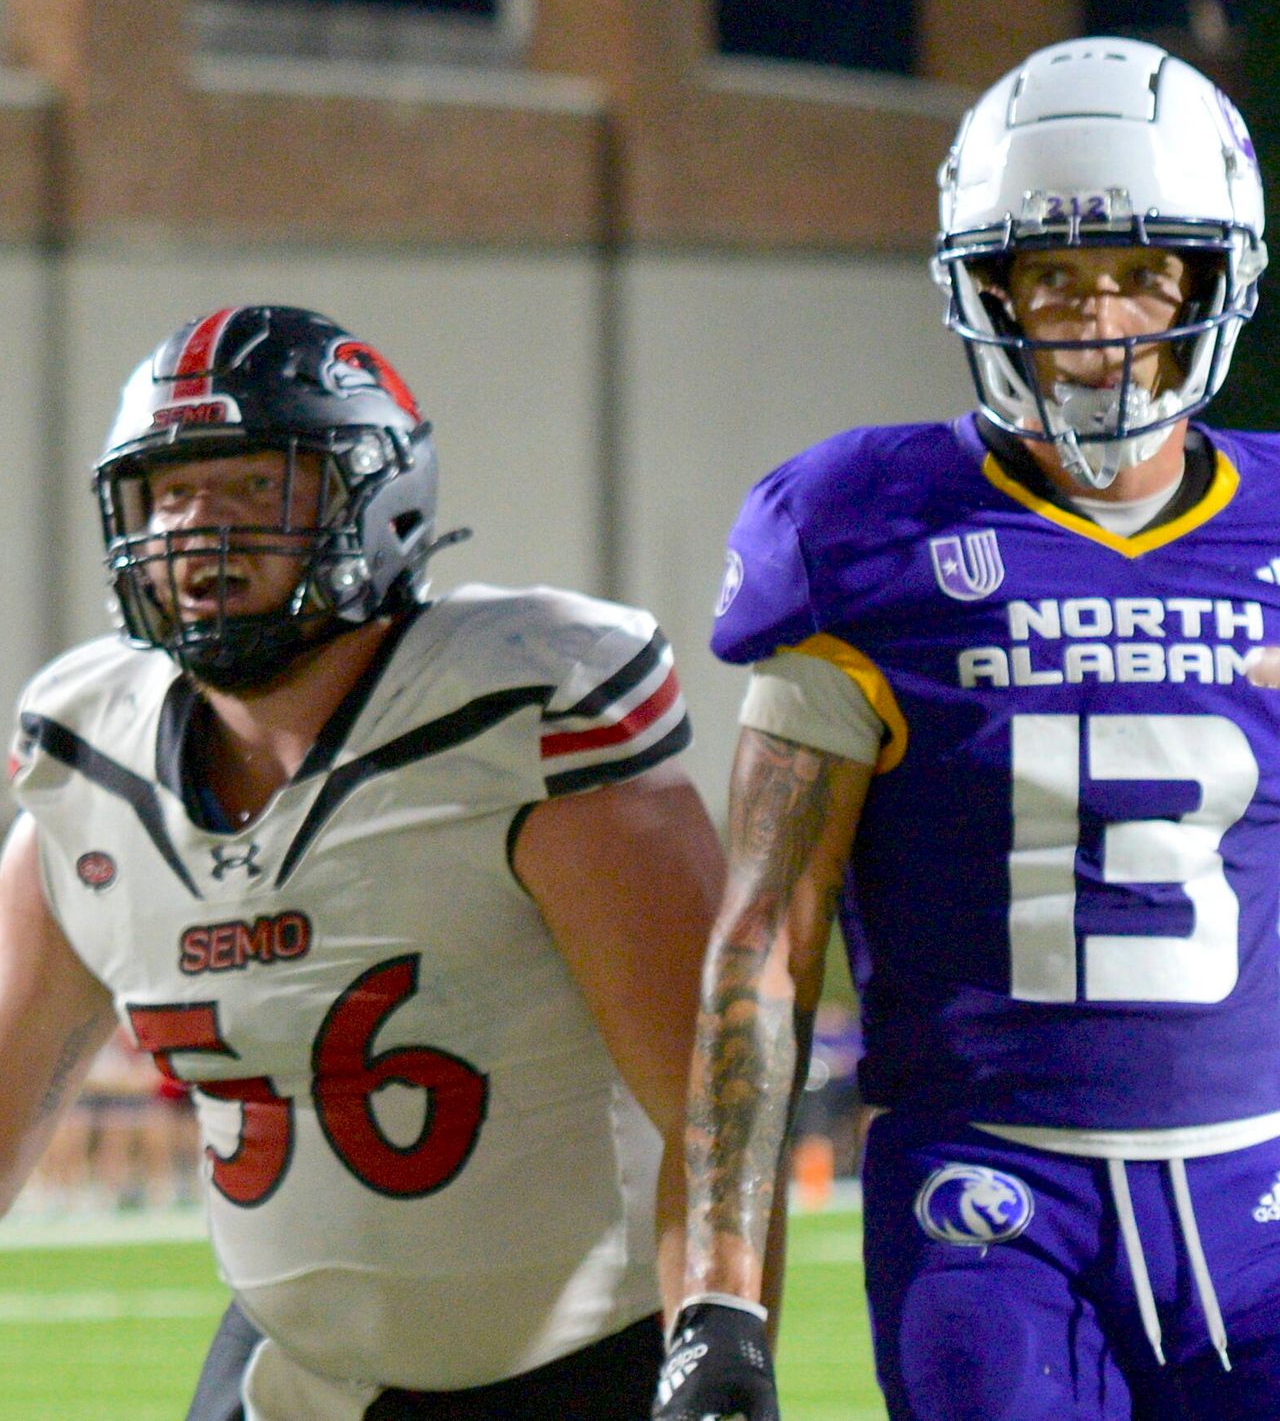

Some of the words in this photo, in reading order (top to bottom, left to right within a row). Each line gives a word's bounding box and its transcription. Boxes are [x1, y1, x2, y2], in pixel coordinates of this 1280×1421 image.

[1007, 596, 1265, 641] NORTH
[956, 642, 1268, 689] ALABAM
[1008, 713, 1260, 1004] 13
[179, 909, 313, 976] SEMO
[125, 951, 491, 1210] 56
